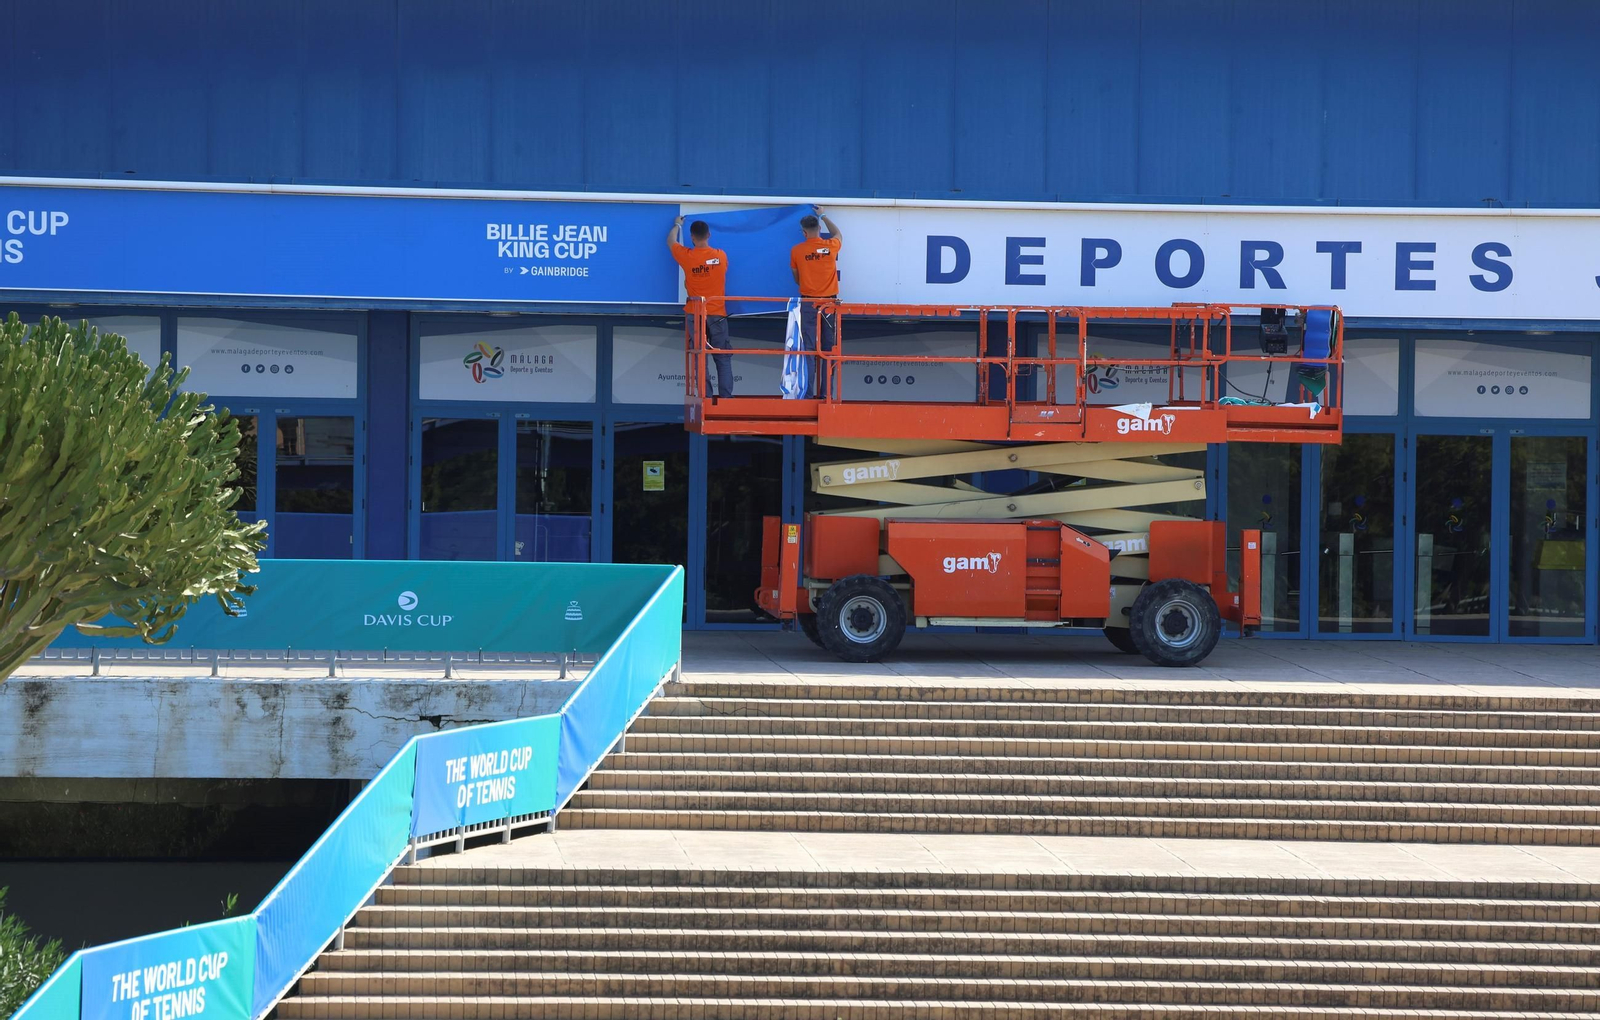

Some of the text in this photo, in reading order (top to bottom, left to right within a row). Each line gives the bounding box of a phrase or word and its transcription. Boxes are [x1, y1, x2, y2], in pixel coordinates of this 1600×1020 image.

[7, 210, 69, 236] CUP
[486, 223, 608, 242] BILLIE JEAN
[498, 241, 598, 260] KING CUP
[530, 265, 589, 277] GAINBRIDGE
[692, 264, 710, 274] enPie
[925, 235, 1514, 293] DEPORTES
[210, 347, 324, 356] www.malagadeporteyeventos.com
[1447, 369, 1558, 378] www.malagadeporteyeventos.com
[1116, 417, 1163, 435] gam
[842, 464, 889, 485] gam
[943, 556, 989, 574] gam
[363, 614, 453, 627] DAVIS CUP
[445, 745, 533, 785] THE WORLD CUP
[457, 775, 516, 809] OF TENNIS
[112, 951, 229, 1003] THE WORLD CUP
[131, 986, 206, 1020] OF TENNIS
